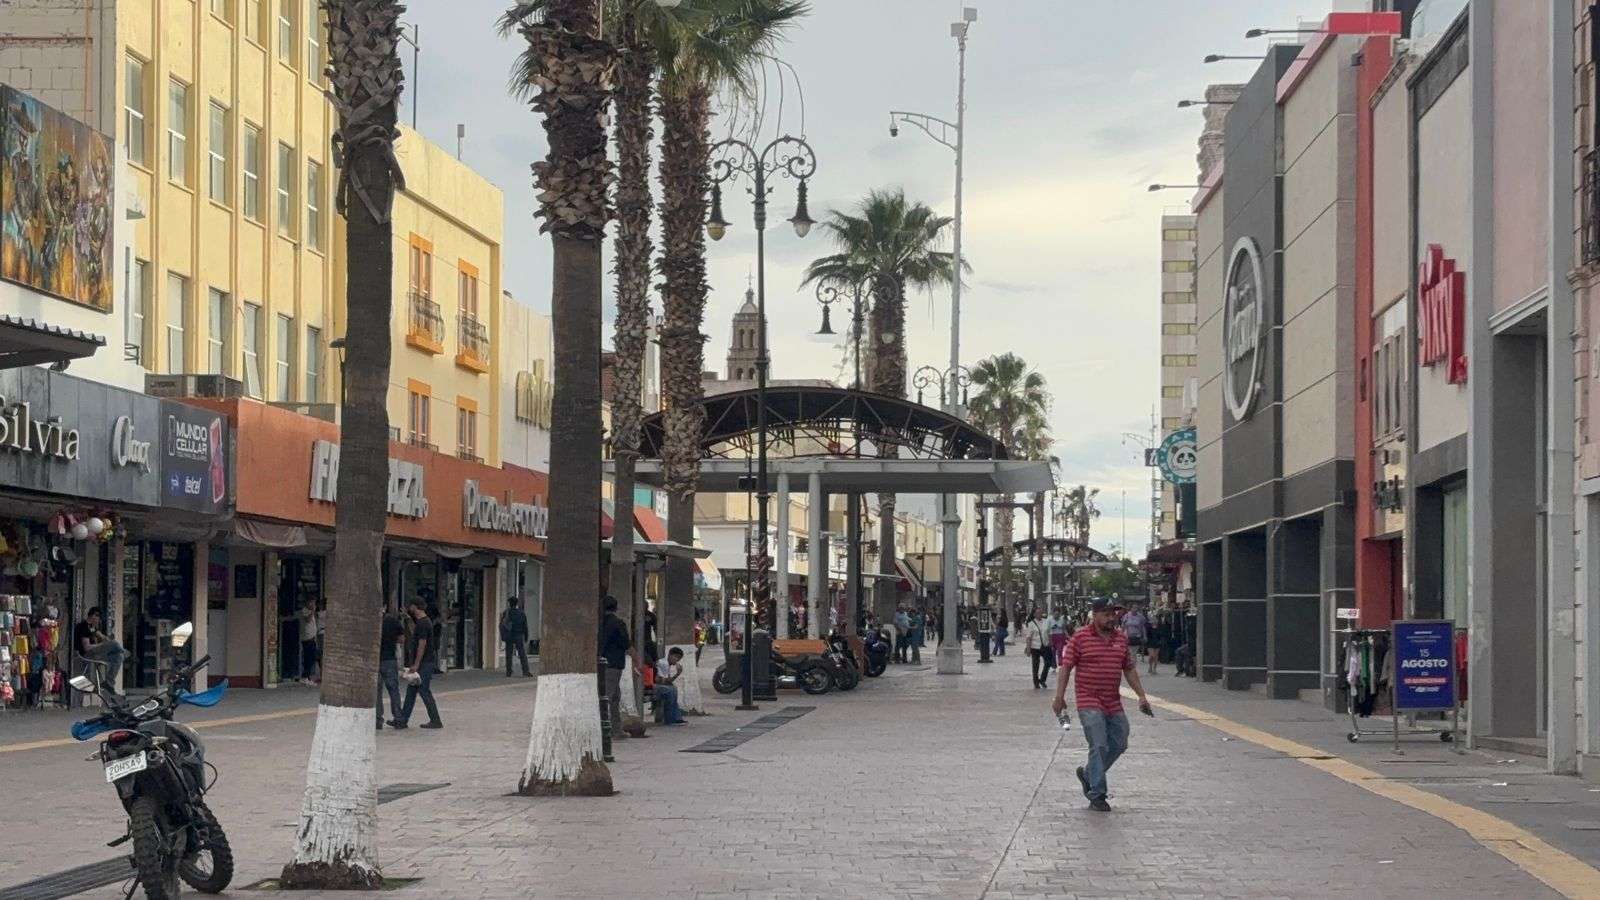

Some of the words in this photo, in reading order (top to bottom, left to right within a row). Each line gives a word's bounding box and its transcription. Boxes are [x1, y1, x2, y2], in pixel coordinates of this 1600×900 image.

[176, 421, 208, 442] MUNDO
[1419, 648, 1430, 658] 15
[1401, 659, 1448, 668] AGOSTO
